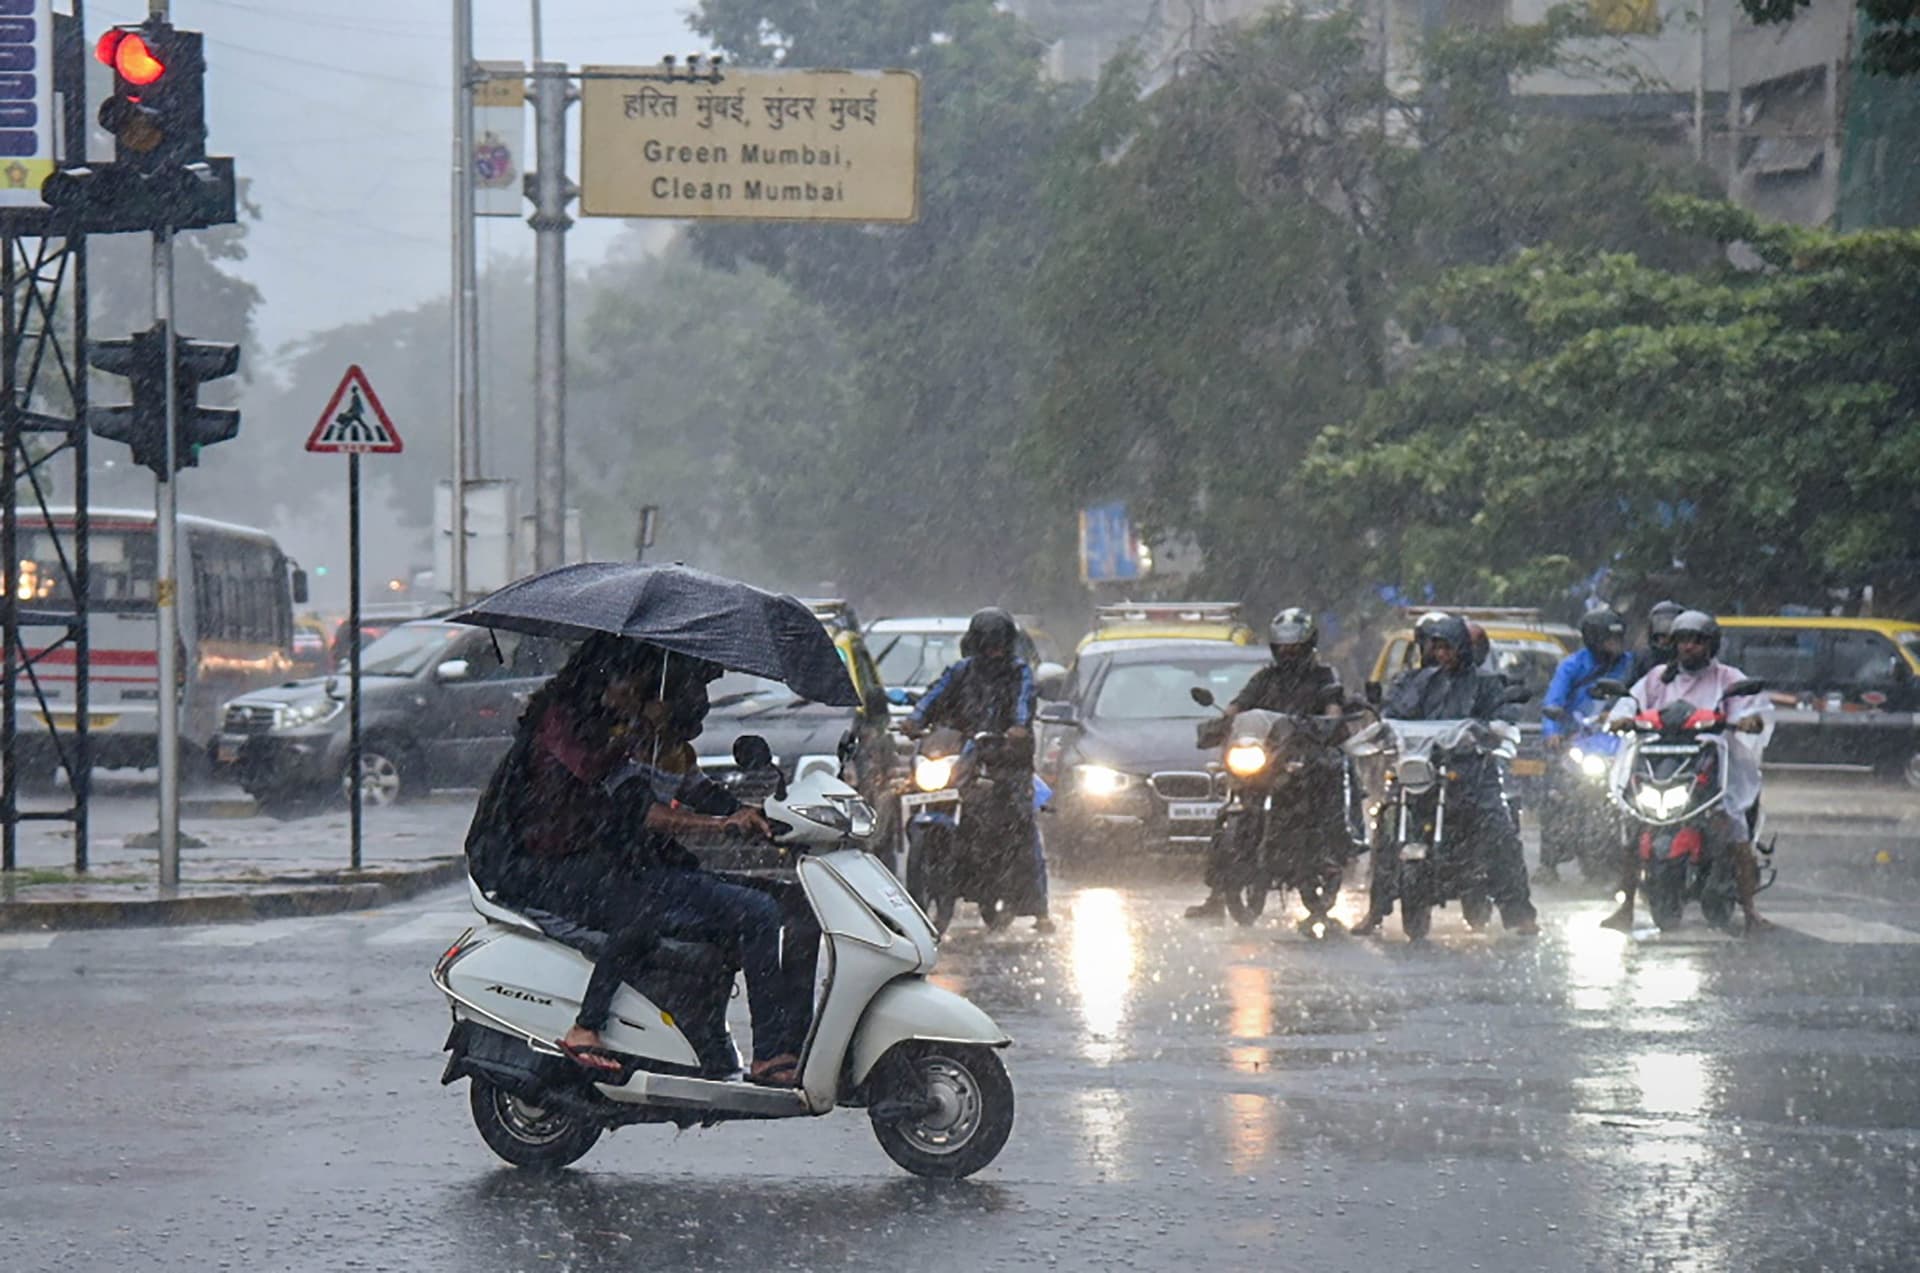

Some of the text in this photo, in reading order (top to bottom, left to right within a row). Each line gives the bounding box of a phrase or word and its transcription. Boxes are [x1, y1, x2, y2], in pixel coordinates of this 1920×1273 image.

[623, 87, 678, 120] हरित
[763, 88, 817, 129] सुंदर
[829, 88, 879, 130] मुंबई
[643, 139, 852, 168] Green Mumbai,
[651, 176, 844, 202] Clean Mumbai
